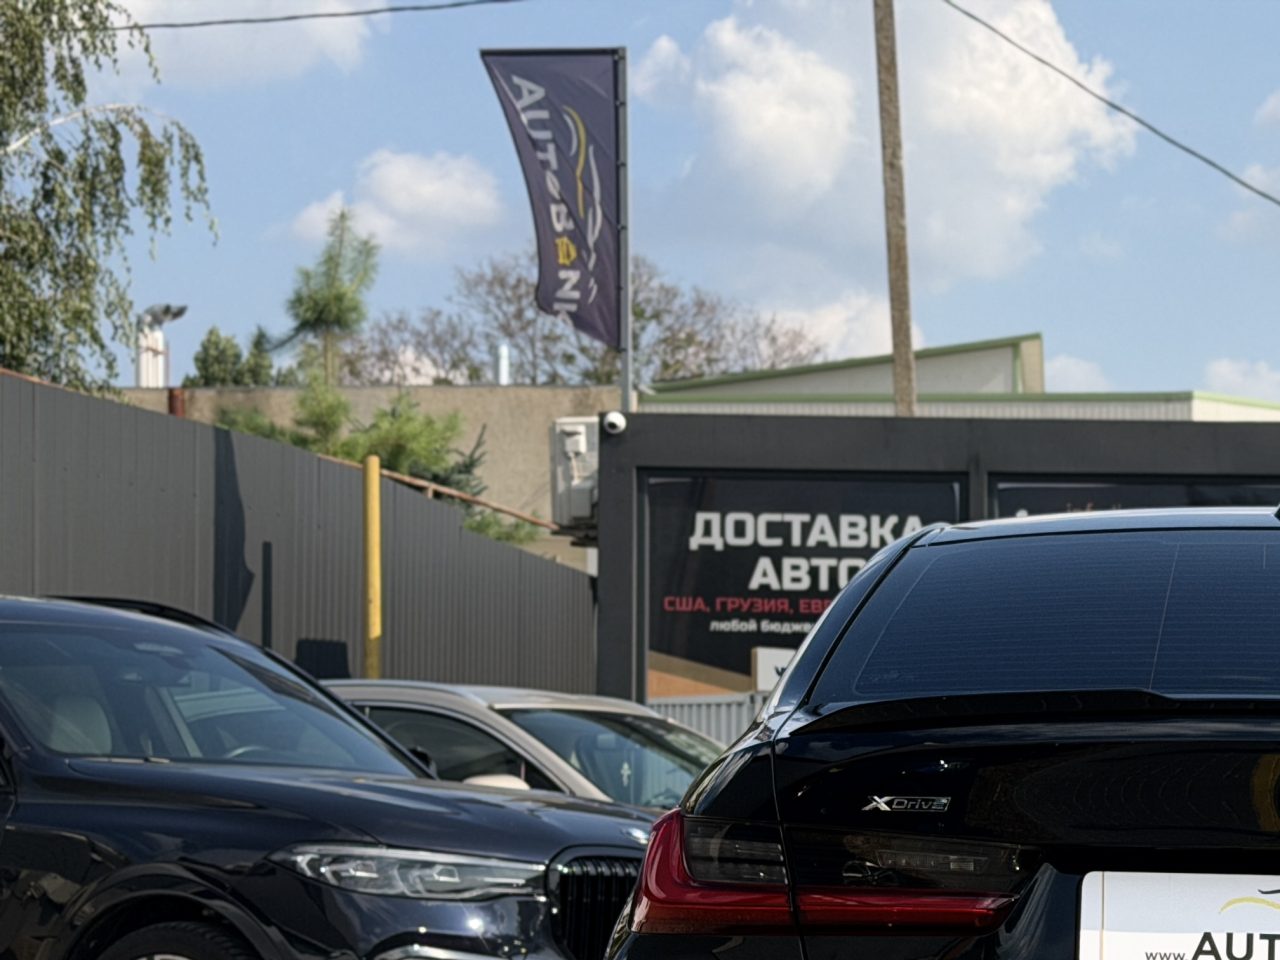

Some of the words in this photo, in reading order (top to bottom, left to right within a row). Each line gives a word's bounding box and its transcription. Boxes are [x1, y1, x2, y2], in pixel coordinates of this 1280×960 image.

[663, 596, 710, 613] США,
[715, 598, 794, 615] ГРУЗИЯ,
[709, 619, 758, 632] любой
